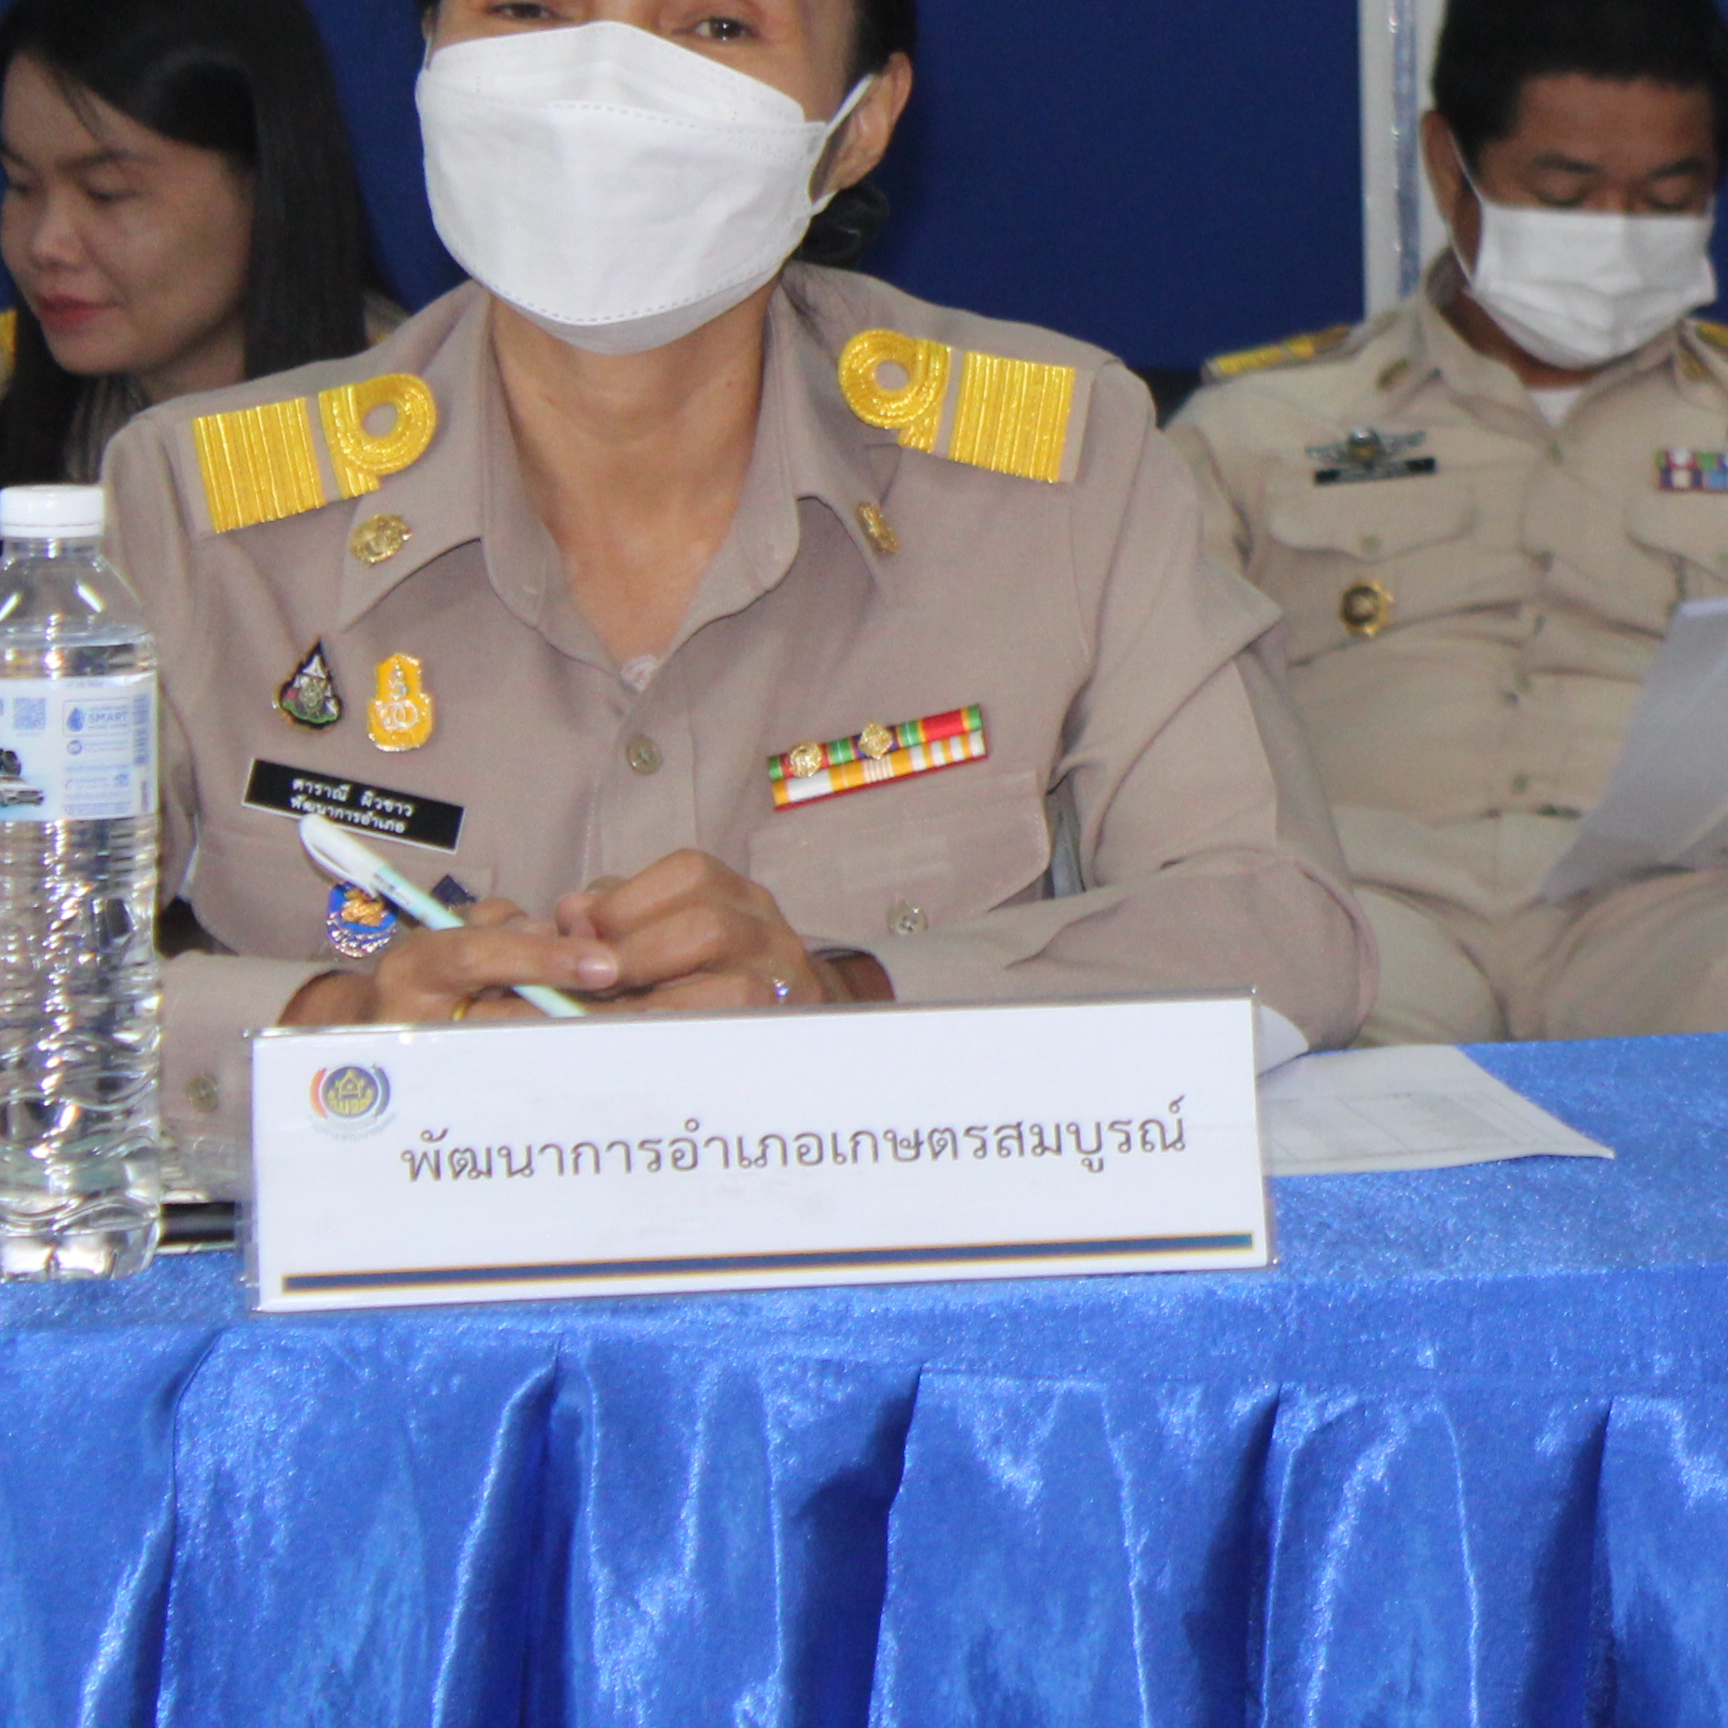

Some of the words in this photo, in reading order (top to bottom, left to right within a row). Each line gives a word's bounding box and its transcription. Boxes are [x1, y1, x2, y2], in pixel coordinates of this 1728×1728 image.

[401, 1095, 1185, 1181] พัฒนาการอำเภอเกษตรสมบูรณ์
